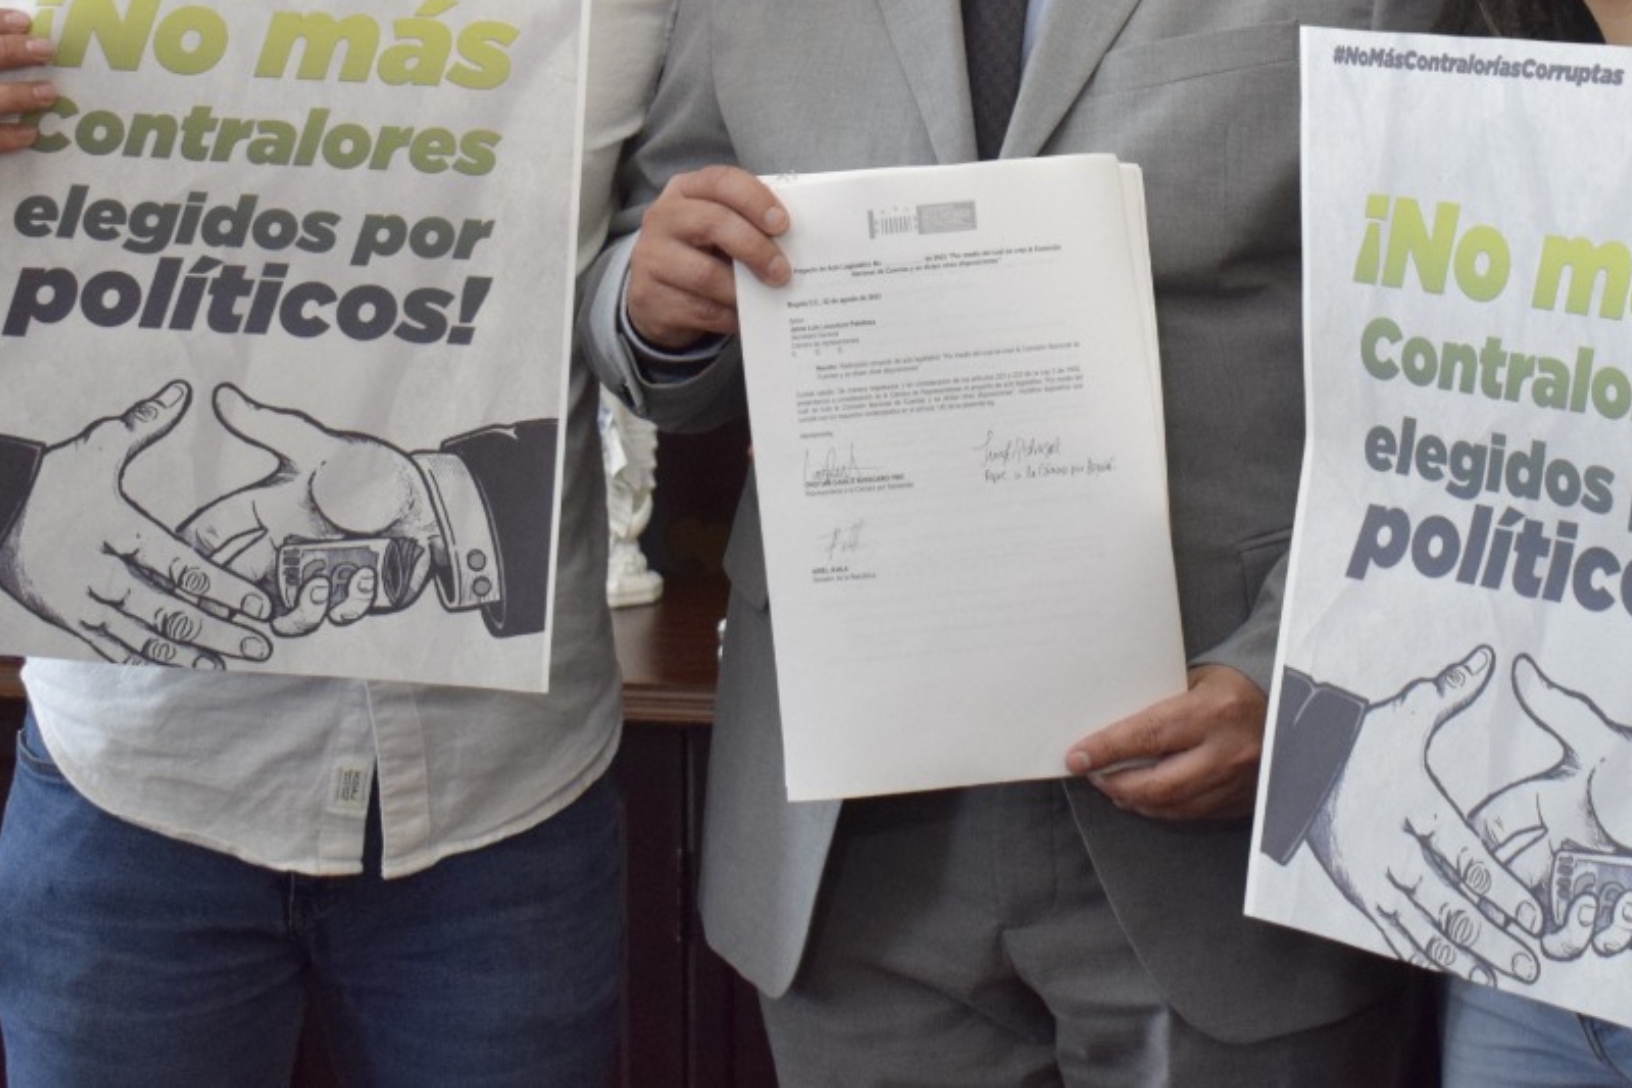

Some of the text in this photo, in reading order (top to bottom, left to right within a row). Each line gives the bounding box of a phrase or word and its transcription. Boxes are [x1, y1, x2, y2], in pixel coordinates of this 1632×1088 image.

[1333, 45, 1625, 86] #NoMásContraloríasCorruptas
[19, 95, 503, 177] Contralores
[14, 185, 495, 266] elegidos por
[1354, 194, 1511, 303] ¡No
[2, 255, 494, 346] políticos!
[1365, 416, 1615, 514] elegidos
